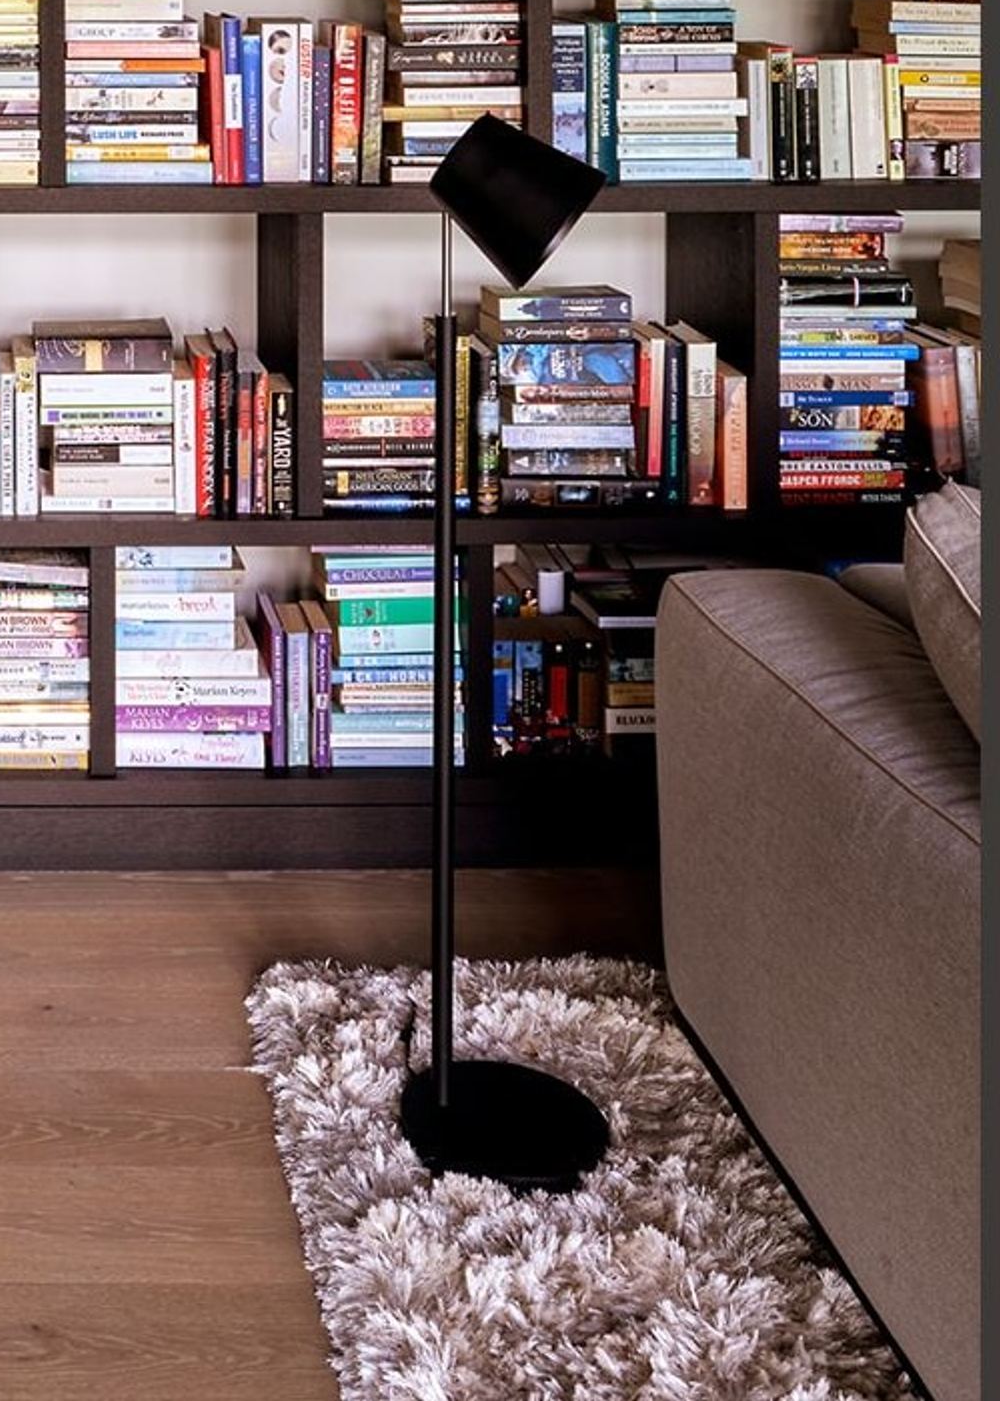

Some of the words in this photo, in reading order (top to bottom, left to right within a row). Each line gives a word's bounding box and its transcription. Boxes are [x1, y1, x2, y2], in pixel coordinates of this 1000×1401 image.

[301, 38, 310, 79] LUSTER
[600, 54, 611, 97] DOUGLAS
[339, 77, 355, 96] ON
[600, 98, 611, 137] ADAMS
[92, 130, 116, 139] LUSH
[119, 130, 138, 139] LIFE
[798, 412, 834, 427] SON
[203, 422, 214, 454] FEAR
[274, 428, 291, 468] YARD
[203, 454, 214, 493] INDEX
[822, 474, 863, 486] FFORDE
[9, 616, 47, 625] BROWN
[15, 640, 53, 650] BROWN
[344, 672, 373, 683] NICK
[193, 686, 228, 695] Marian
[230, 686, 257, 696] Keyes
[125, 708, 170, 717] MARIAN
[131, 718, 164, 728] KEYES
